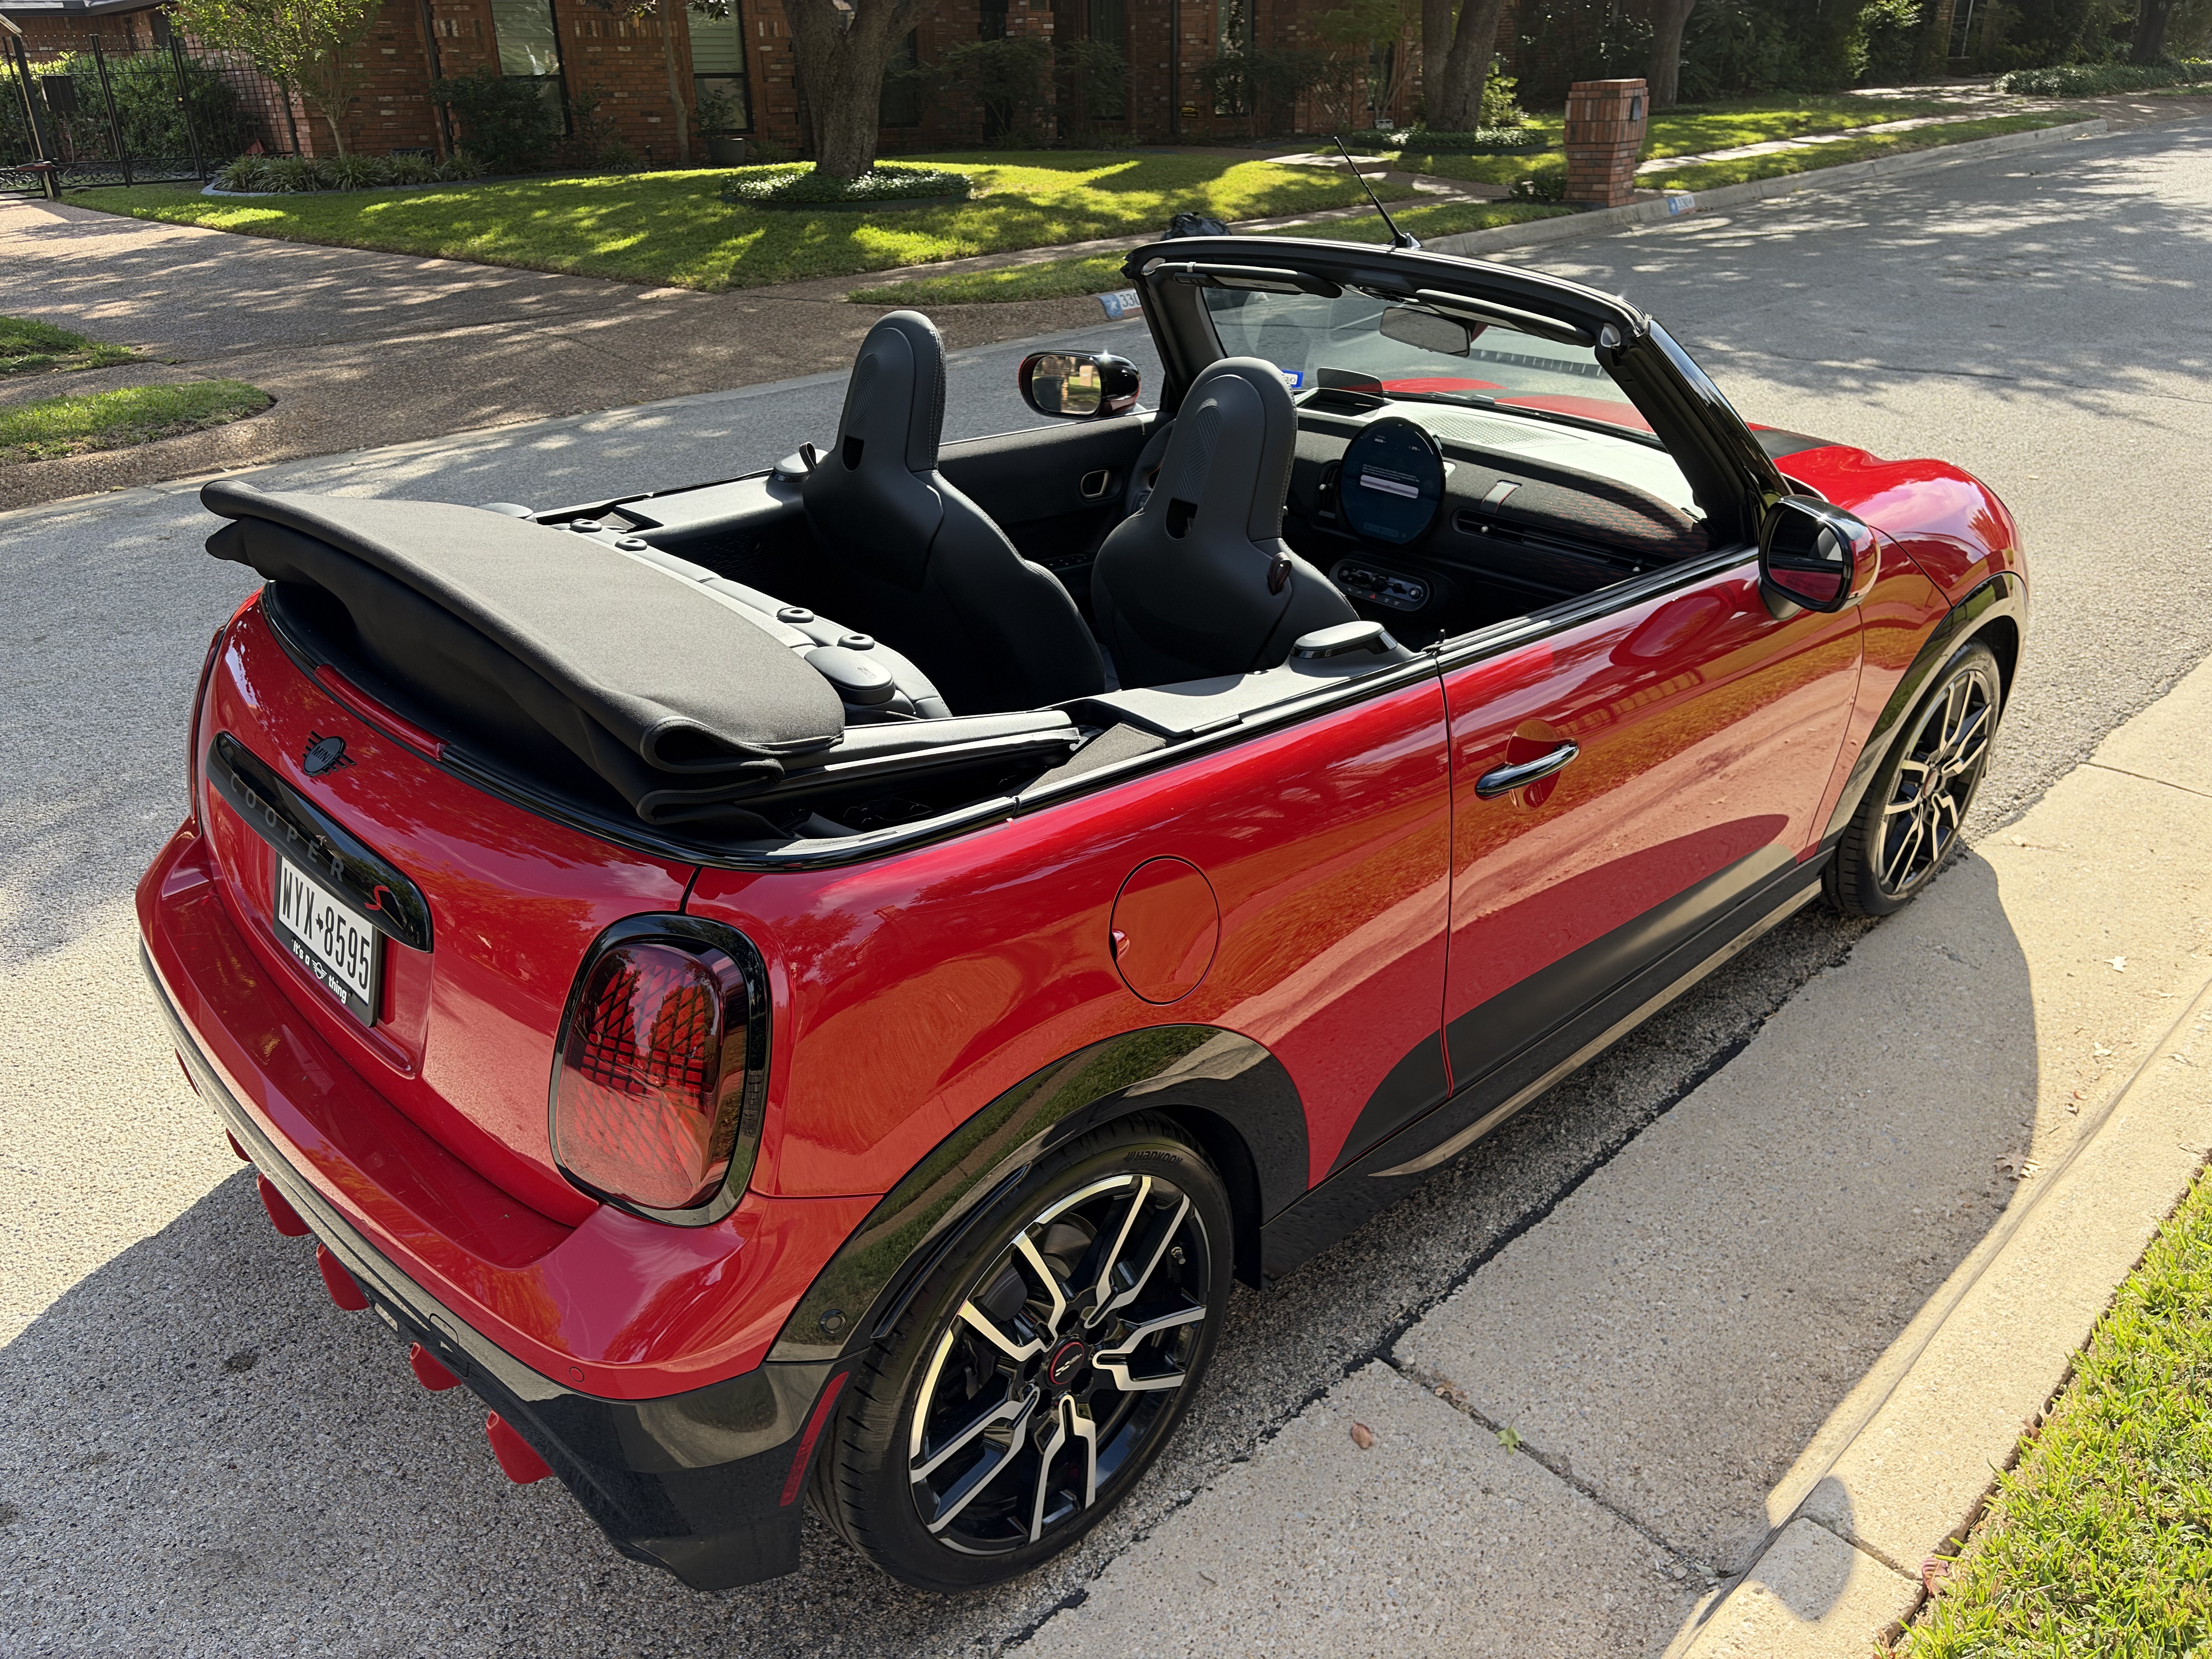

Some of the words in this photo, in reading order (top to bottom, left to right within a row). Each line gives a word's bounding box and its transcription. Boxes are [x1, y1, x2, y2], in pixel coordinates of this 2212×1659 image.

[312, 746, 333, 764] MINI
[230, 772, 345, 883] COOPER
[365, 885, 390, 911] S
[283, 867, 315, 940] WYX
[324, 906, 370, 990] 8595
[293, 940, 304, 960] It's
[305, 954, 310, 966] a
[328, 975, 347, 1004] thing
